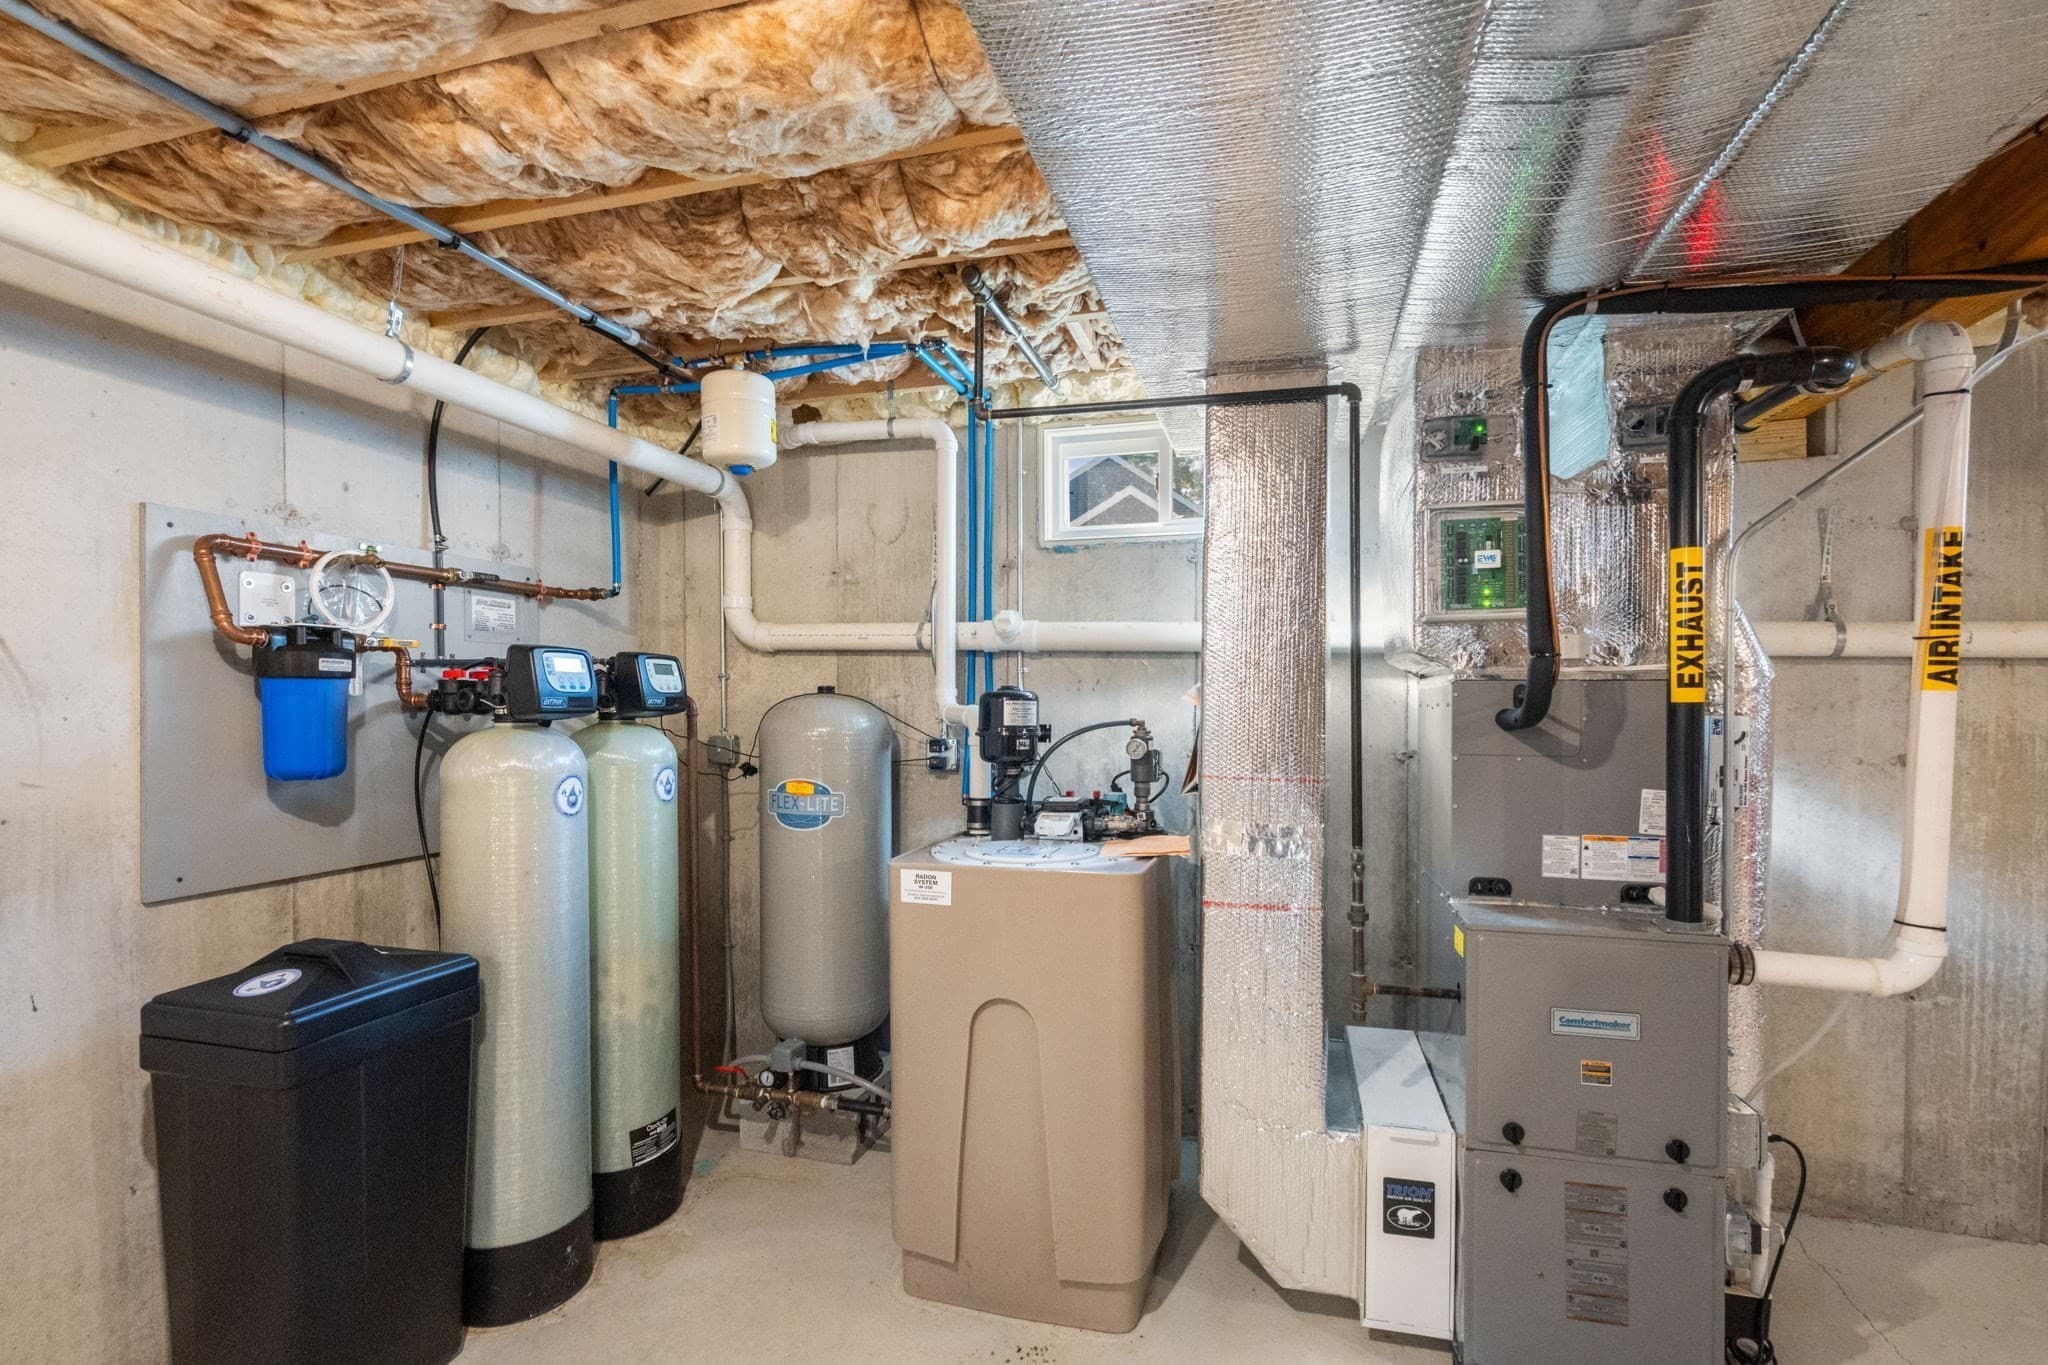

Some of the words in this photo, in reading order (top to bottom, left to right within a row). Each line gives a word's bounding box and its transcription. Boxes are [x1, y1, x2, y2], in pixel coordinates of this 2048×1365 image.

[1930, 531, 1963, 630] INTAKE
[1676, 562, 1704, 688] EXHAUST
[1927, 640, 1960, 686] AIR
[1559, 1016, 1632, 1029] Comfortmaker
